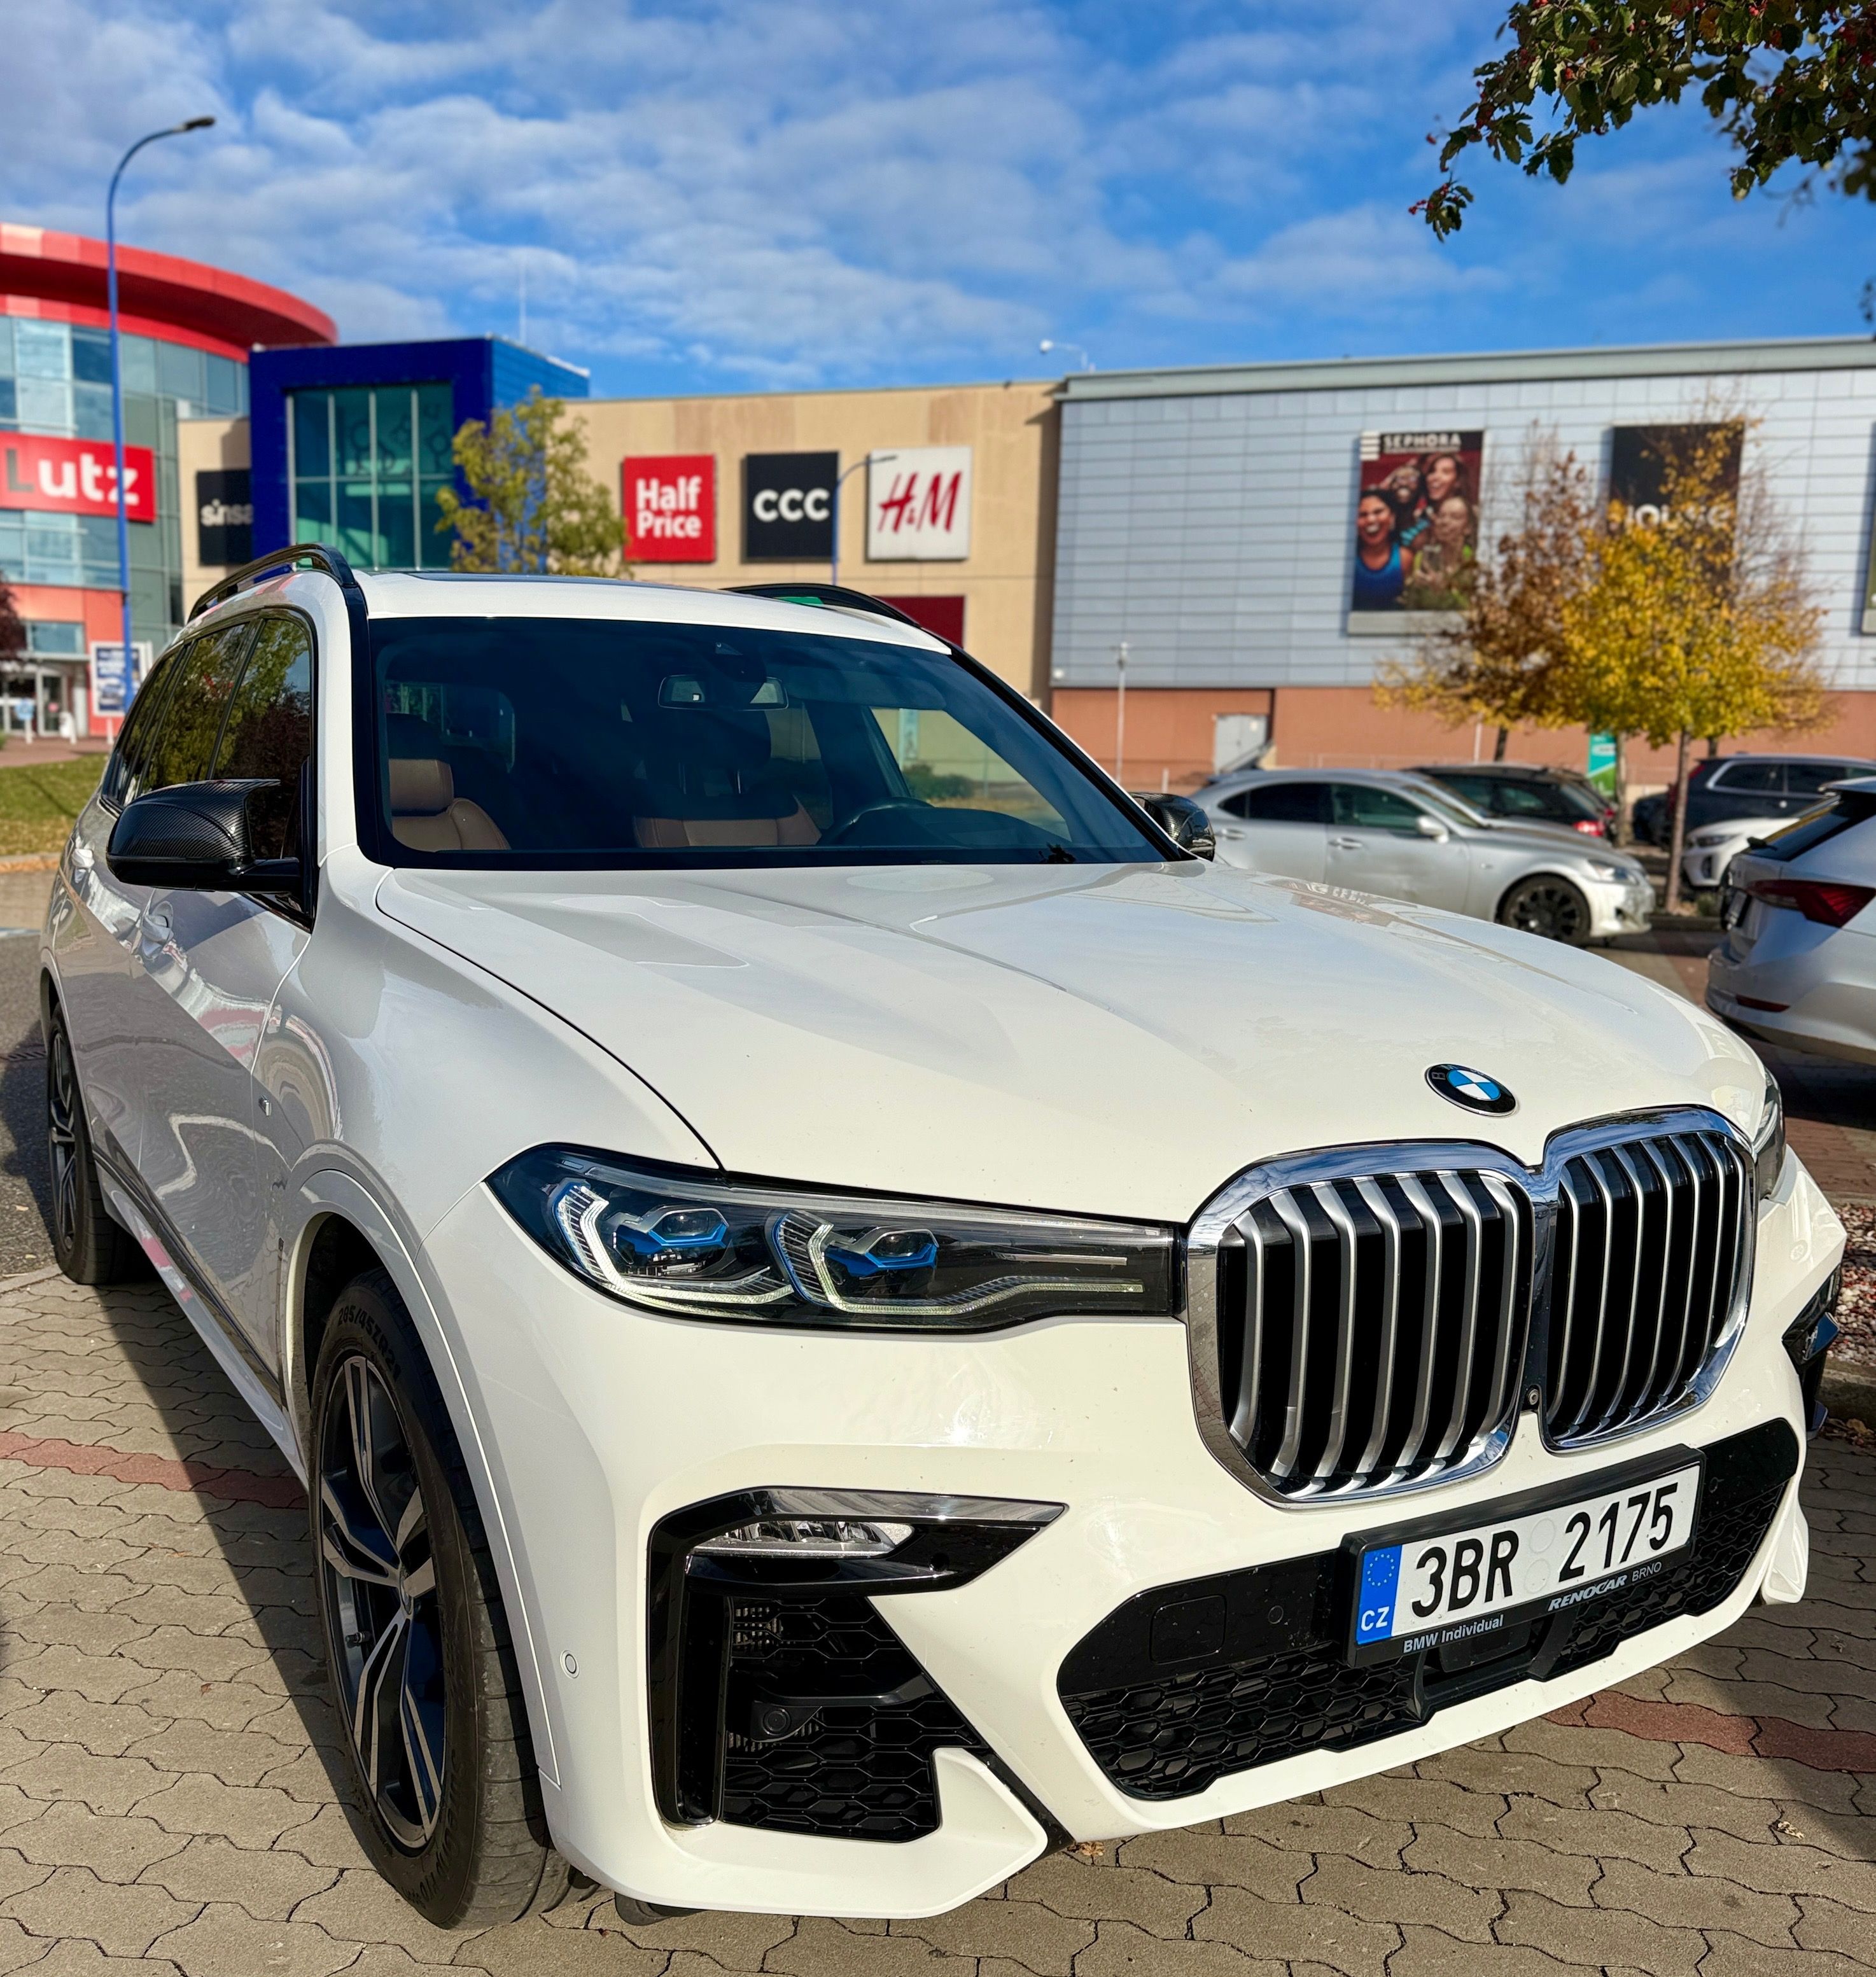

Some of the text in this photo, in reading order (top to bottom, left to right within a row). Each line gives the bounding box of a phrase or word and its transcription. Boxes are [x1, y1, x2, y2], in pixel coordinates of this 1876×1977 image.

[1383, 433, 1462, 447] SEPHORA
[636, 476, 701, 510] Half
[878, 471, 962, 533] H&M
[636, 512, 701, 539] Price
[1411, 1482, 1679, 1618] 3BR 2175
[1547, 1561, 1662, 1612] RENOCAR BRNO
[1361, 1607, 1389, 1631] CZ
[1403, 1614, 1504, 1653] BMW Individual
